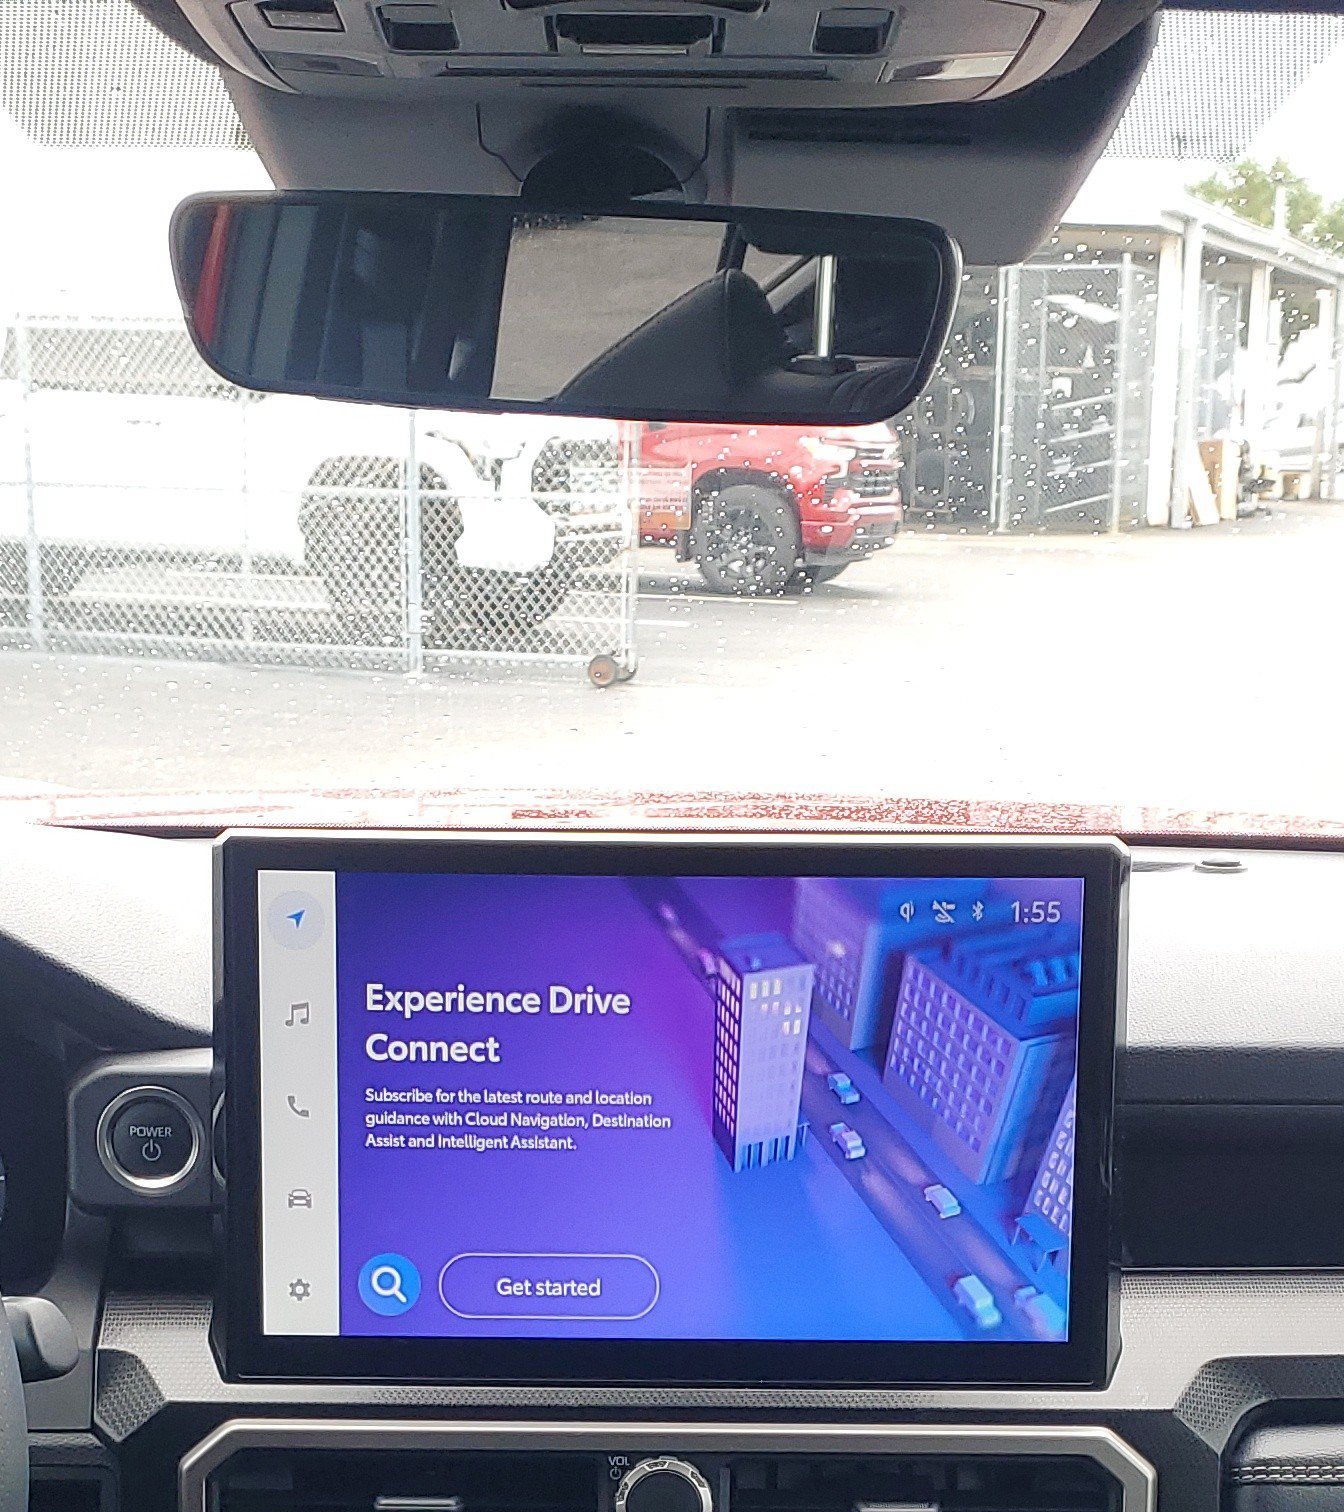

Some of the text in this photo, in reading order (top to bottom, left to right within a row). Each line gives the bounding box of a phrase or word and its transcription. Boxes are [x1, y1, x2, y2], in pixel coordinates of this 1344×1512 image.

[1011, 901, 1062, 924] 1:55
[366, 984, 632, 1019] Experience Drive
[365, 1034, 501, 1063] Connect
[365, 1088, 652, 1106] Subscribe for the latest route and location
[365, 1110, 672, 1130] guidance with Cloud Navigation, Destination
[129, 1126, 172, 1138] POWER
[365, 1134, 577, 1152] Assist and Intelligent Assistant.
[496, 1278, 602, 1297] Get started
[608, 1456, 630, 1466] VOL
